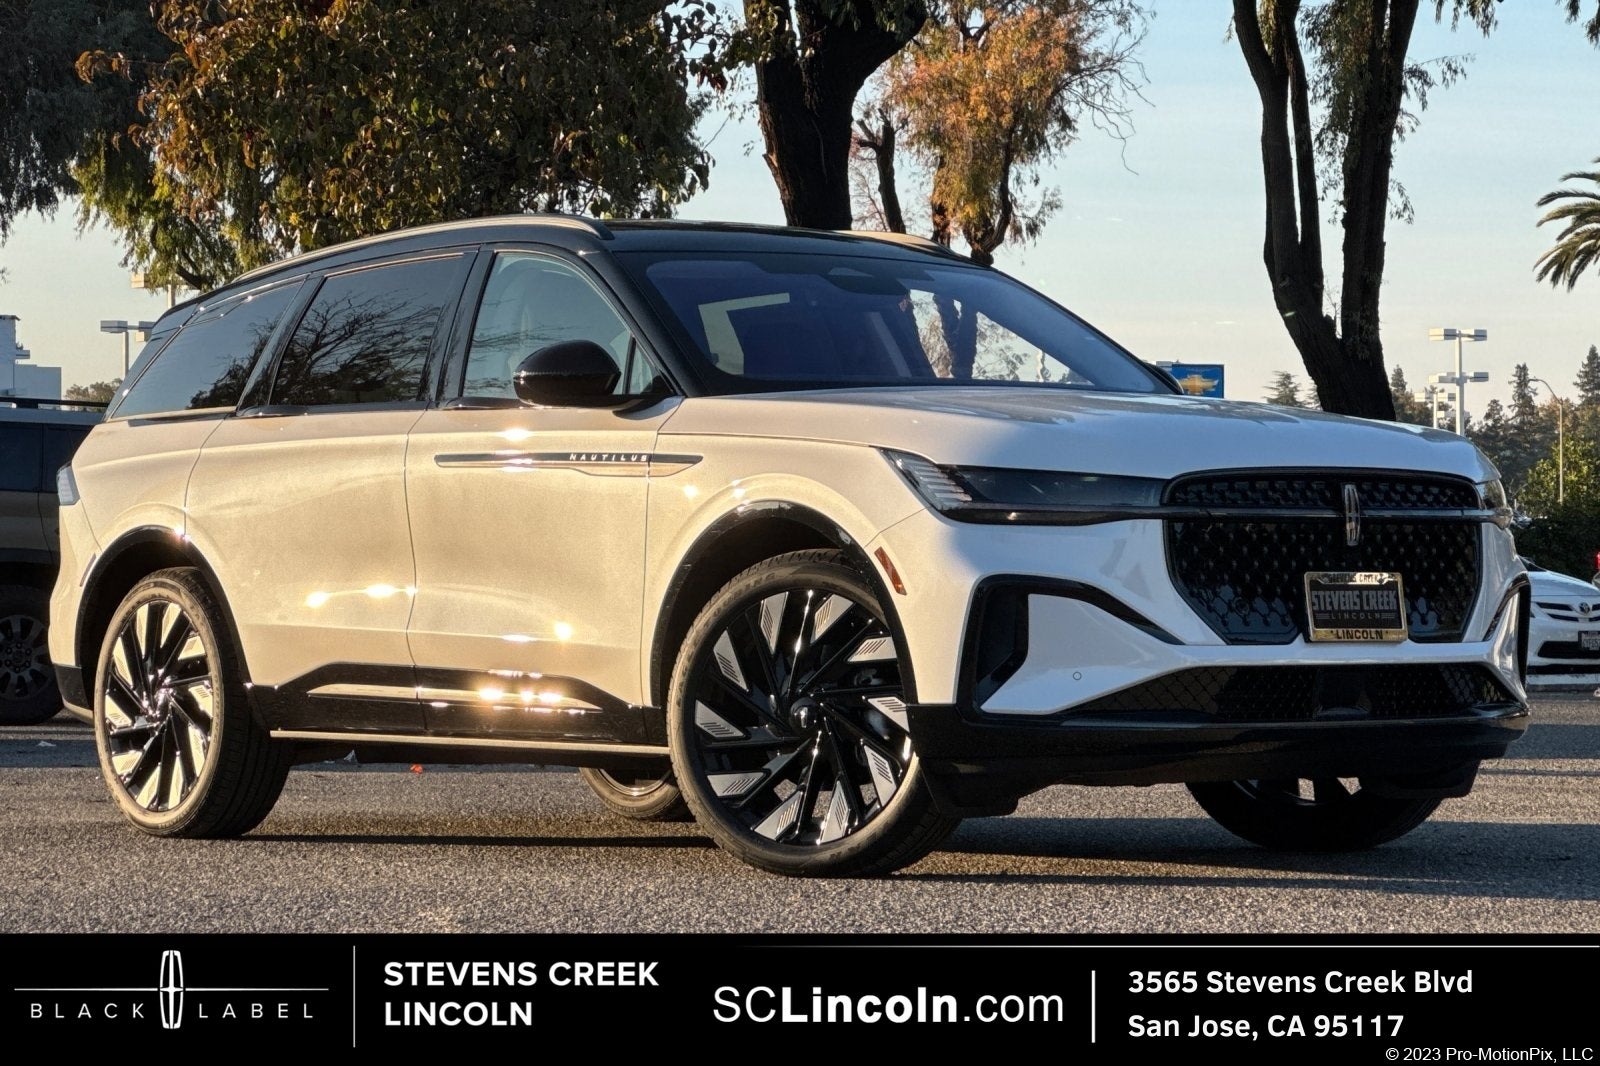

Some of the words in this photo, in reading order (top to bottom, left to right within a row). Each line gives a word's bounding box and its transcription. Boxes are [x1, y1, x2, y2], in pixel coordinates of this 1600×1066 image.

[569, 453, 648, 462] NAUTILUS
[1311, 590, 1360, 611] STEVENS
[1362, 590, 1398, 611] CREEK
[1331, 612, 1381, 620] LINCOLN
[1336, 629, 1384, 640] LINCOLN
